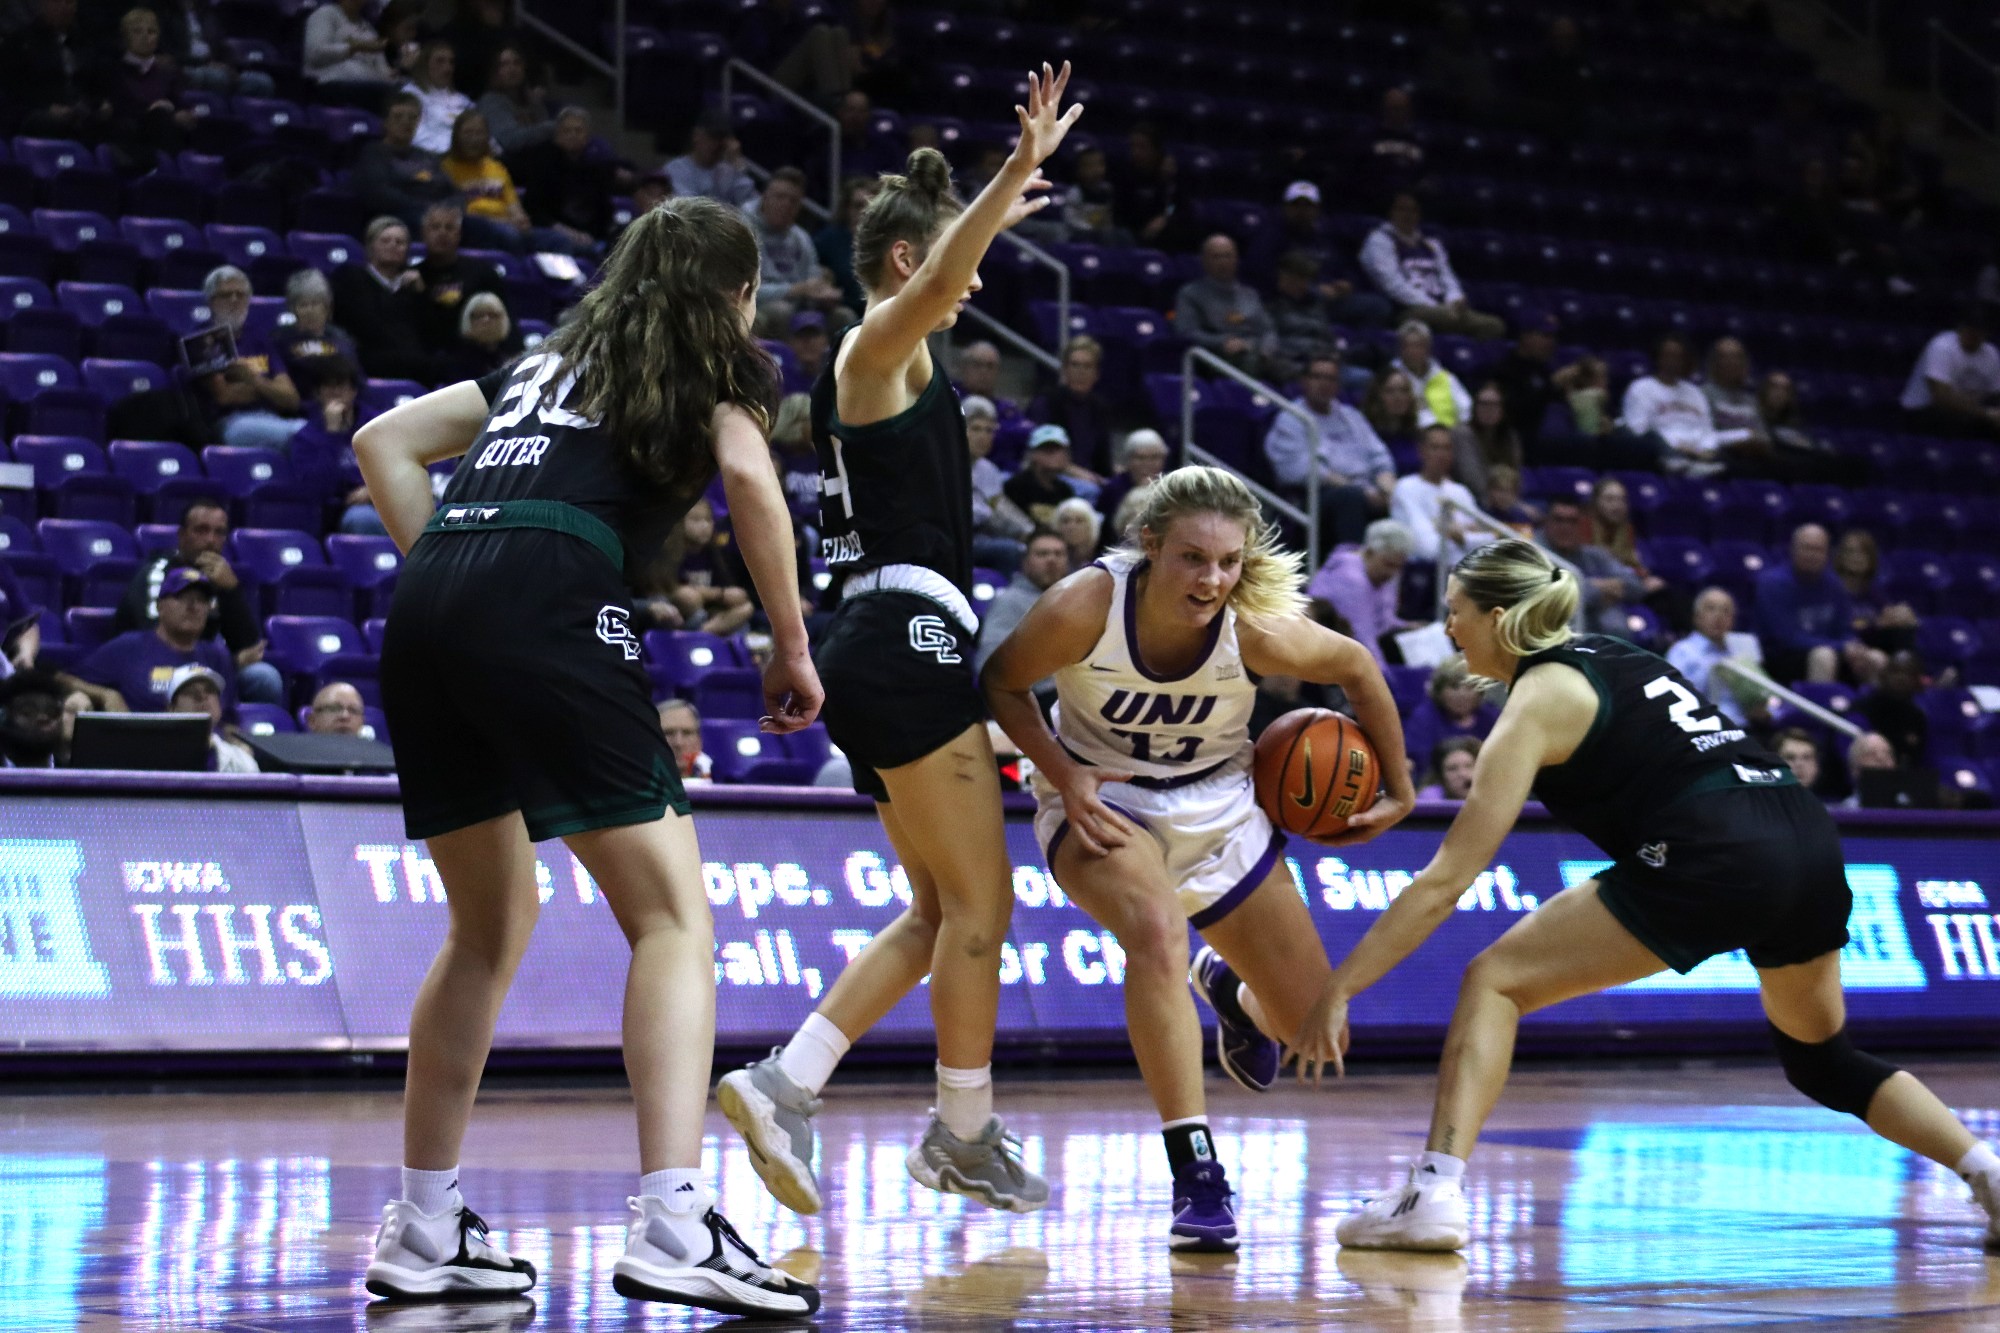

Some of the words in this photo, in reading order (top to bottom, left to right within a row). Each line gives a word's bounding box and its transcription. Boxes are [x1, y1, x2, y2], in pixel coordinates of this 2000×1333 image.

[475, 435, 551, 470] GUYER
[1100, 689, 1218, 726] UNI
[1643, 675, 1722, 733] 2
[1331, 748, 1366, 818] ELITE
[121, 861, 231, 893] IOWA
[130, 904, 333, 986] HHS
